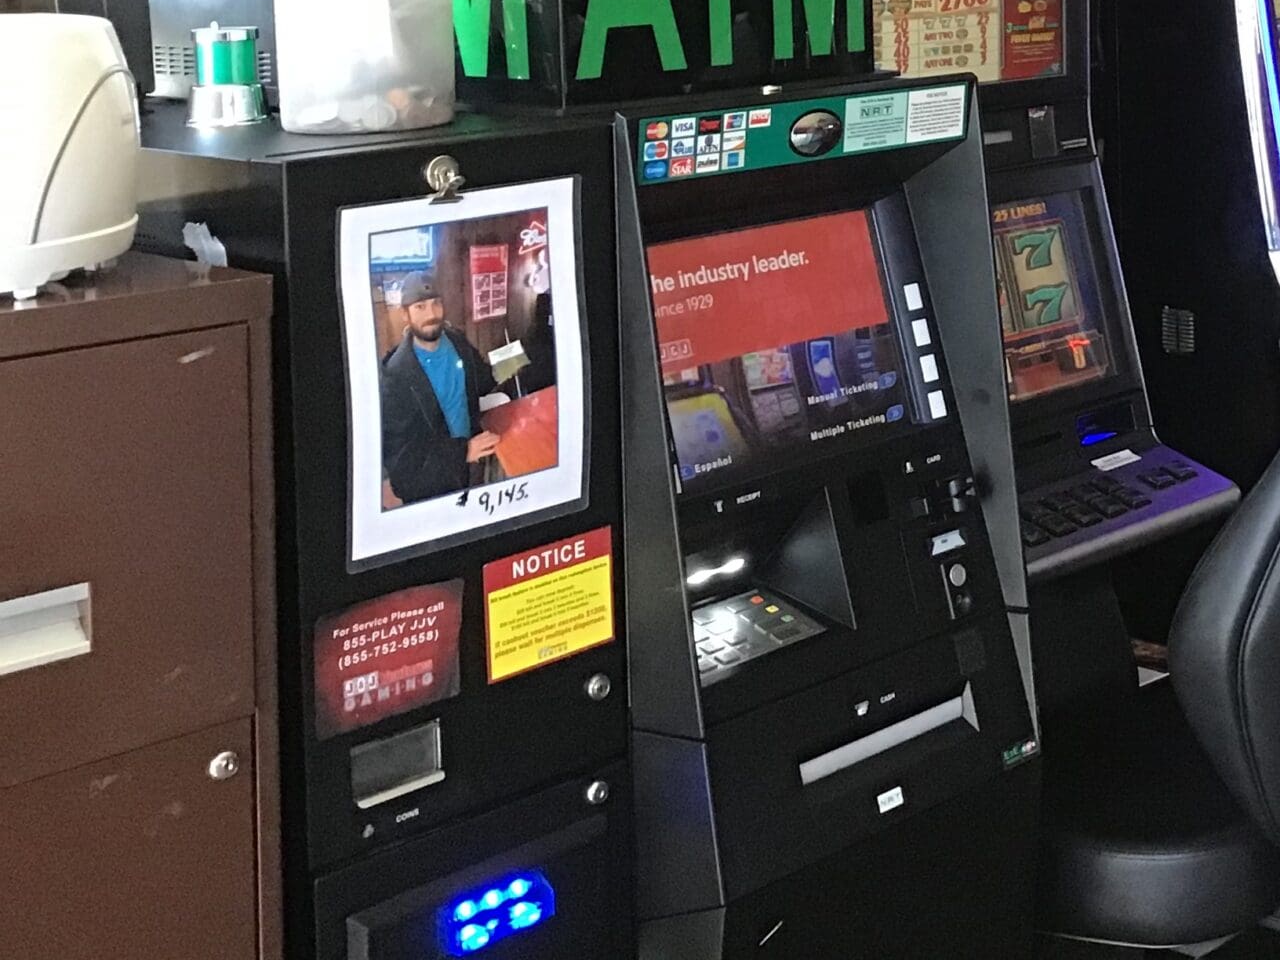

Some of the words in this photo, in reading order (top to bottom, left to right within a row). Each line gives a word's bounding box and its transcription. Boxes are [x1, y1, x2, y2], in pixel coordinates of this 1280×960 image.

[861, 105, 892, 117] NRT
[675, 122, 694, 133] VISA
[671, 165, 692, 175] STAR
[994, 209, 1009, 223] 25
[1012, 228, 1058, 272] 7
[651, 274, 675, 293] he
[678, 261, 750, 289] industry
[752, 249, 809, 274] leader.
[656, 302, 684, 318] ince
[686, 294, 713, 312] 1929
[1024, 282, 1069, 326] 7
[807, 392, 838, 405] Manual
[840, 379, 878, 396] Ticketing
[810, 424, 845, 441] Multiple
[847, 413, 886, 433] Ticketing
[695, 453, 732, 473] Español
[736, 490, 761, 504] RECEIPT
[512, 540, 586, 579] NOTICE
[333, 628, 350, 639] For
[352, 616, 388, 632] Service
[390, 607, 424, 621] Please
[427, 601, 445, 613] call
[343, 622, 406, 651] 855-PLAY
[410, 616, 437, 631] JJV
[338, 629, 440, 670] (855-752-9558)
[395, 807, 420, 823] COINS
